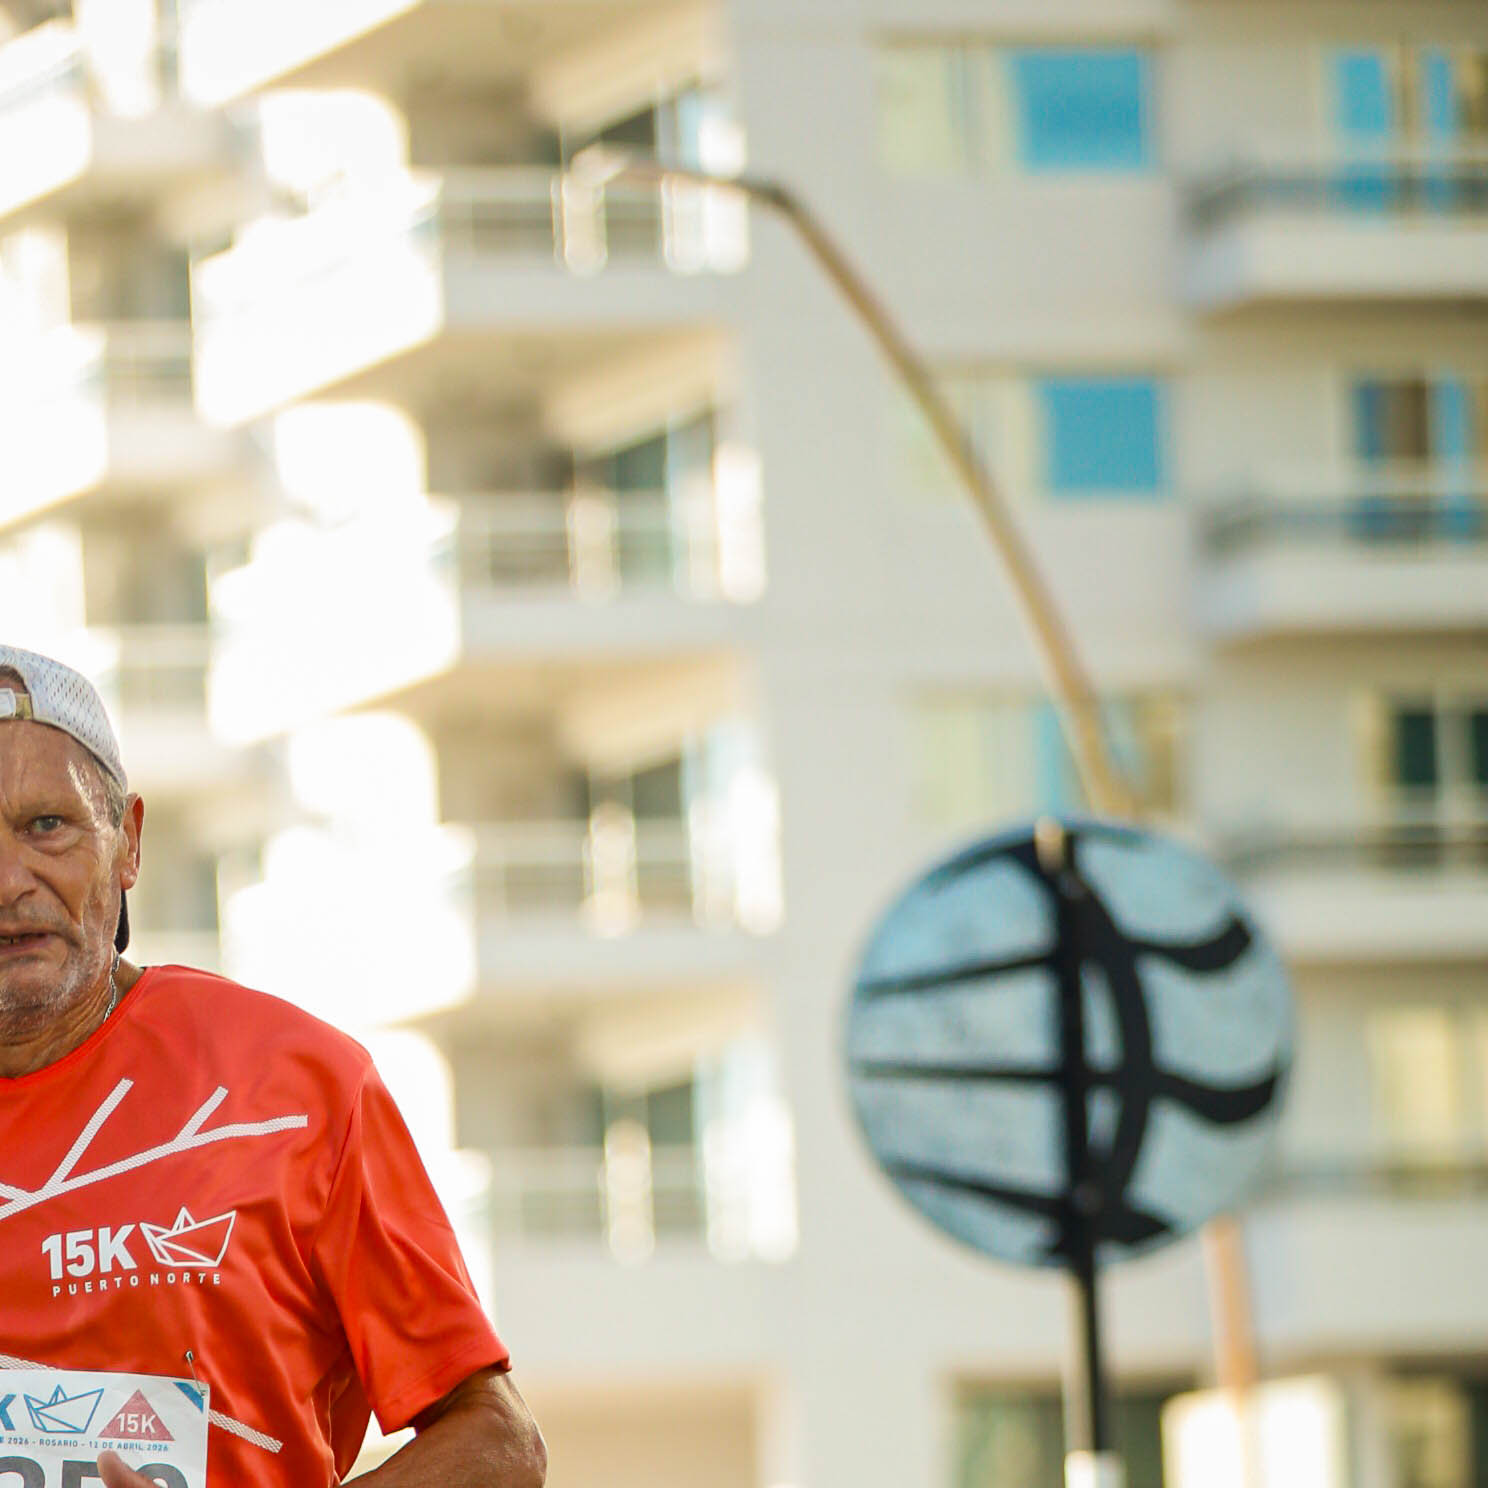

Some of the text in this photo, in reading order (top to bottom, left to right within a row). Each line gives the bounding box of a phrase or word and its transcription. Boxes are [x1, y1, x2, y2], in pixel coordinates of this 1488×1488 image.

[41, 1223, 138, 1280] 15K
[52, 1272, 221, 1297] PUERTO NORTE
[116, 1413, 157, 1434] 15K
[7, 1437, 30, 1445] 2026
[39, 1438, 78, 1447] ROSARIO
[89, 1440, 99, 1448] 12
[102, 1441, 113, 1449] DE
[117, 1442, 143, 1450] ABRIL
